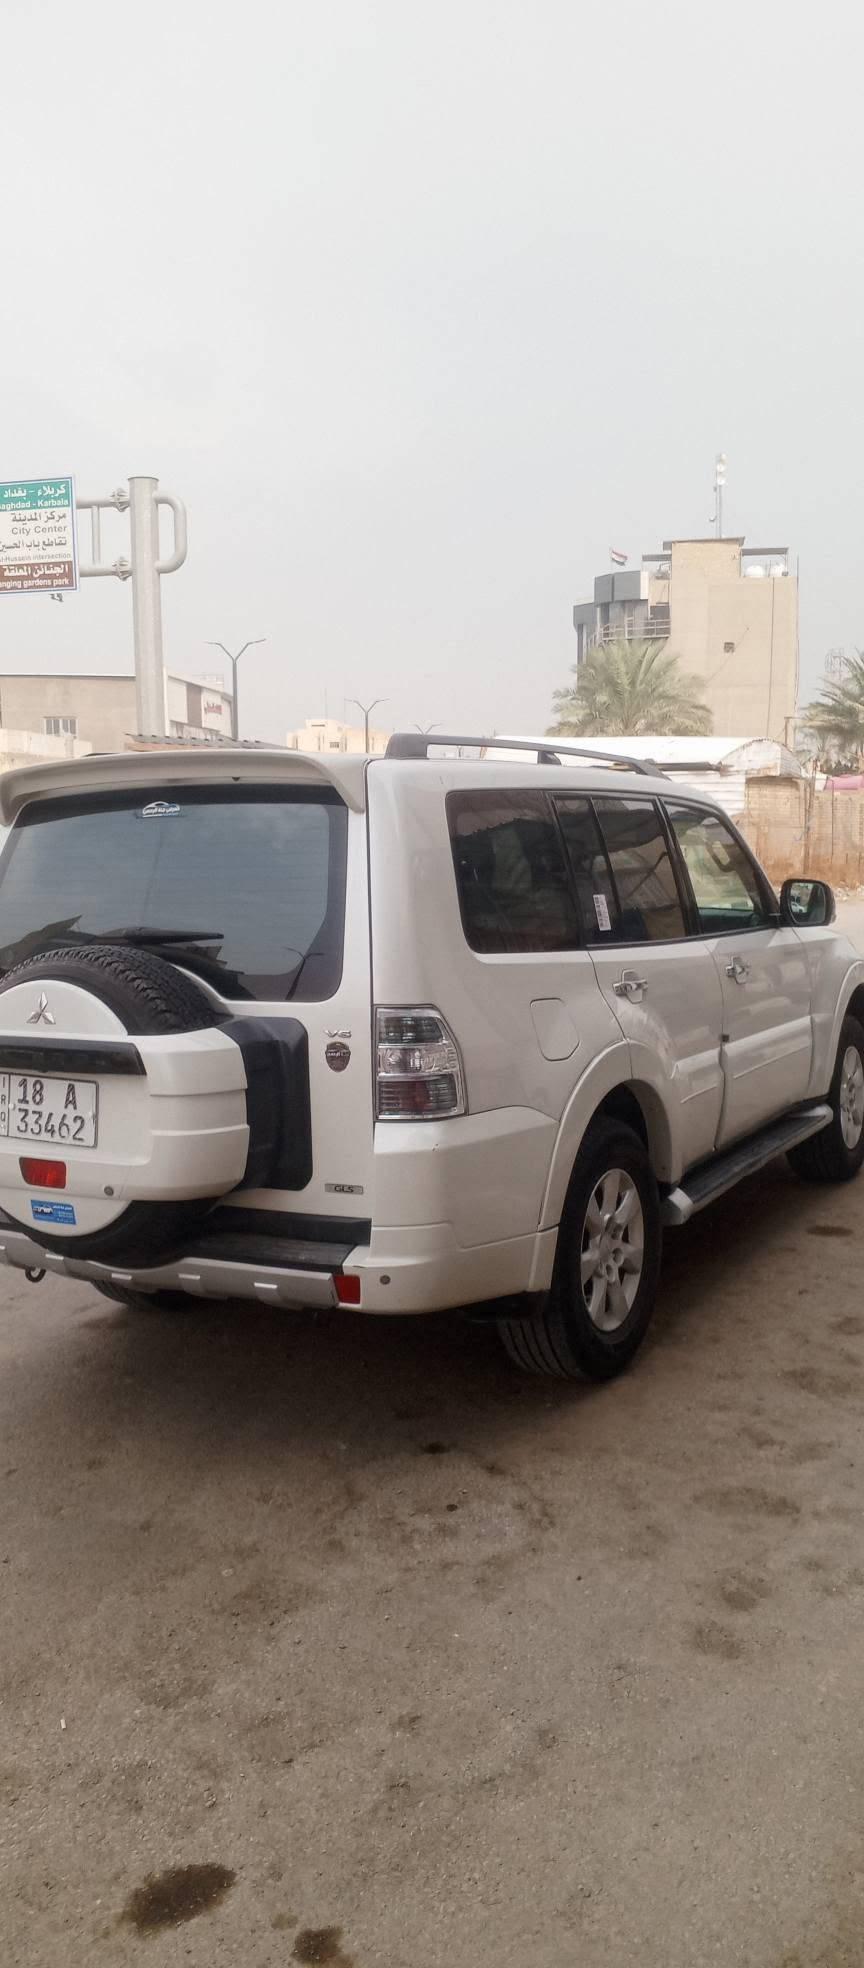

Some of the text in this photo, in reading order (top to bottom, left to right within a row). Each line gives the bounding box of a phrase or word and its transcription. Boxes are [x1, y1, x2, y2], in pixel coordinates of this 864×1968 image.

[3, 487, 27, 500] بغداد
[37, 484, 66, 497] كربلاء
[0, 501, 31, 511] aghdad
[37, 498, 69, 507] Karbala
[11, 510, 66, 526] مركز المدينة
[11, 525, 67, 536] City Center
[26, 539, 40, 551] باب
[42, 536, 67, 551] تقاطع
[3, 563, 69, 578] الجنائن المعلقة
[23, 578, 52, 588] gardens
[52, 577, 70, 587] park
[17, 1078, 77, 1111] 18 A
[17, 1107, 85, 1141] 33462
[334, 1185, 354, 1193] GLS
